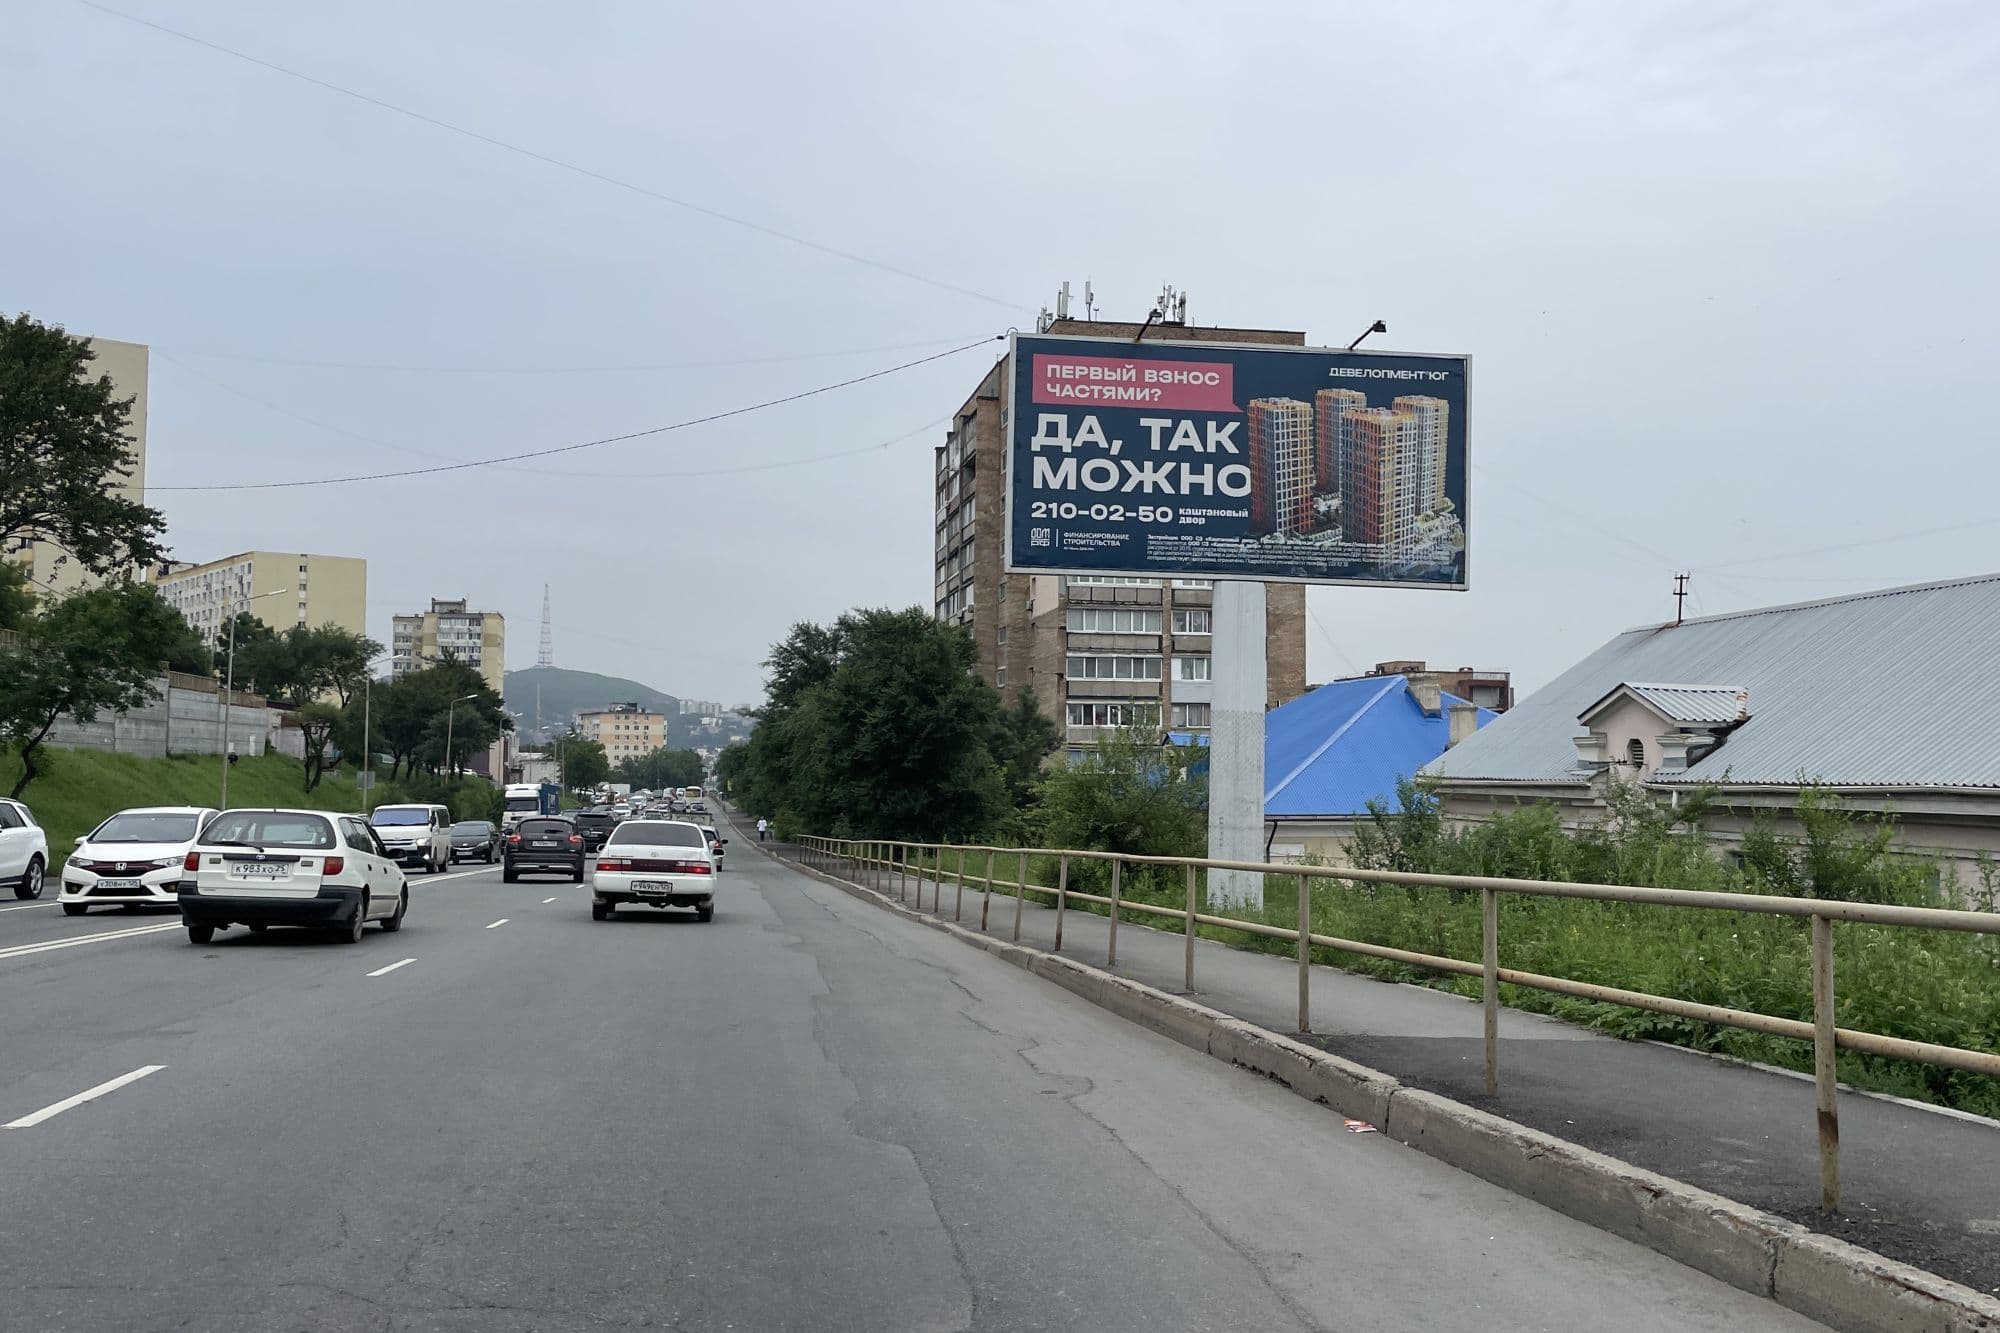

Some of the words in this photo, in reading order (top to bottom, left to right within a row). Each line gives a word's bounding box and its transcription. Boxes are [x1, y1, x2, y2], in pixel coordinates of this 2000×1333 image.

[1047, 364, 1137, 382] ПЕРВЫЙ
[1144, 369, 1220, 386] ВЗНОС
[1047, 384, 1162, 401] ЧАСТЯМИ?
[1031, 413, 1123, 455] ДА,
[1139, 417, 1241, 454] ТАК
[1032, 456, 1251, 498] МОЖНО
[1031, 501, 1173, 523] 210-02-50
[1179, 516, 1206, 525] двор
[1063, 532, 1130, 540] ФИНАНСИРОВАНИЕ
